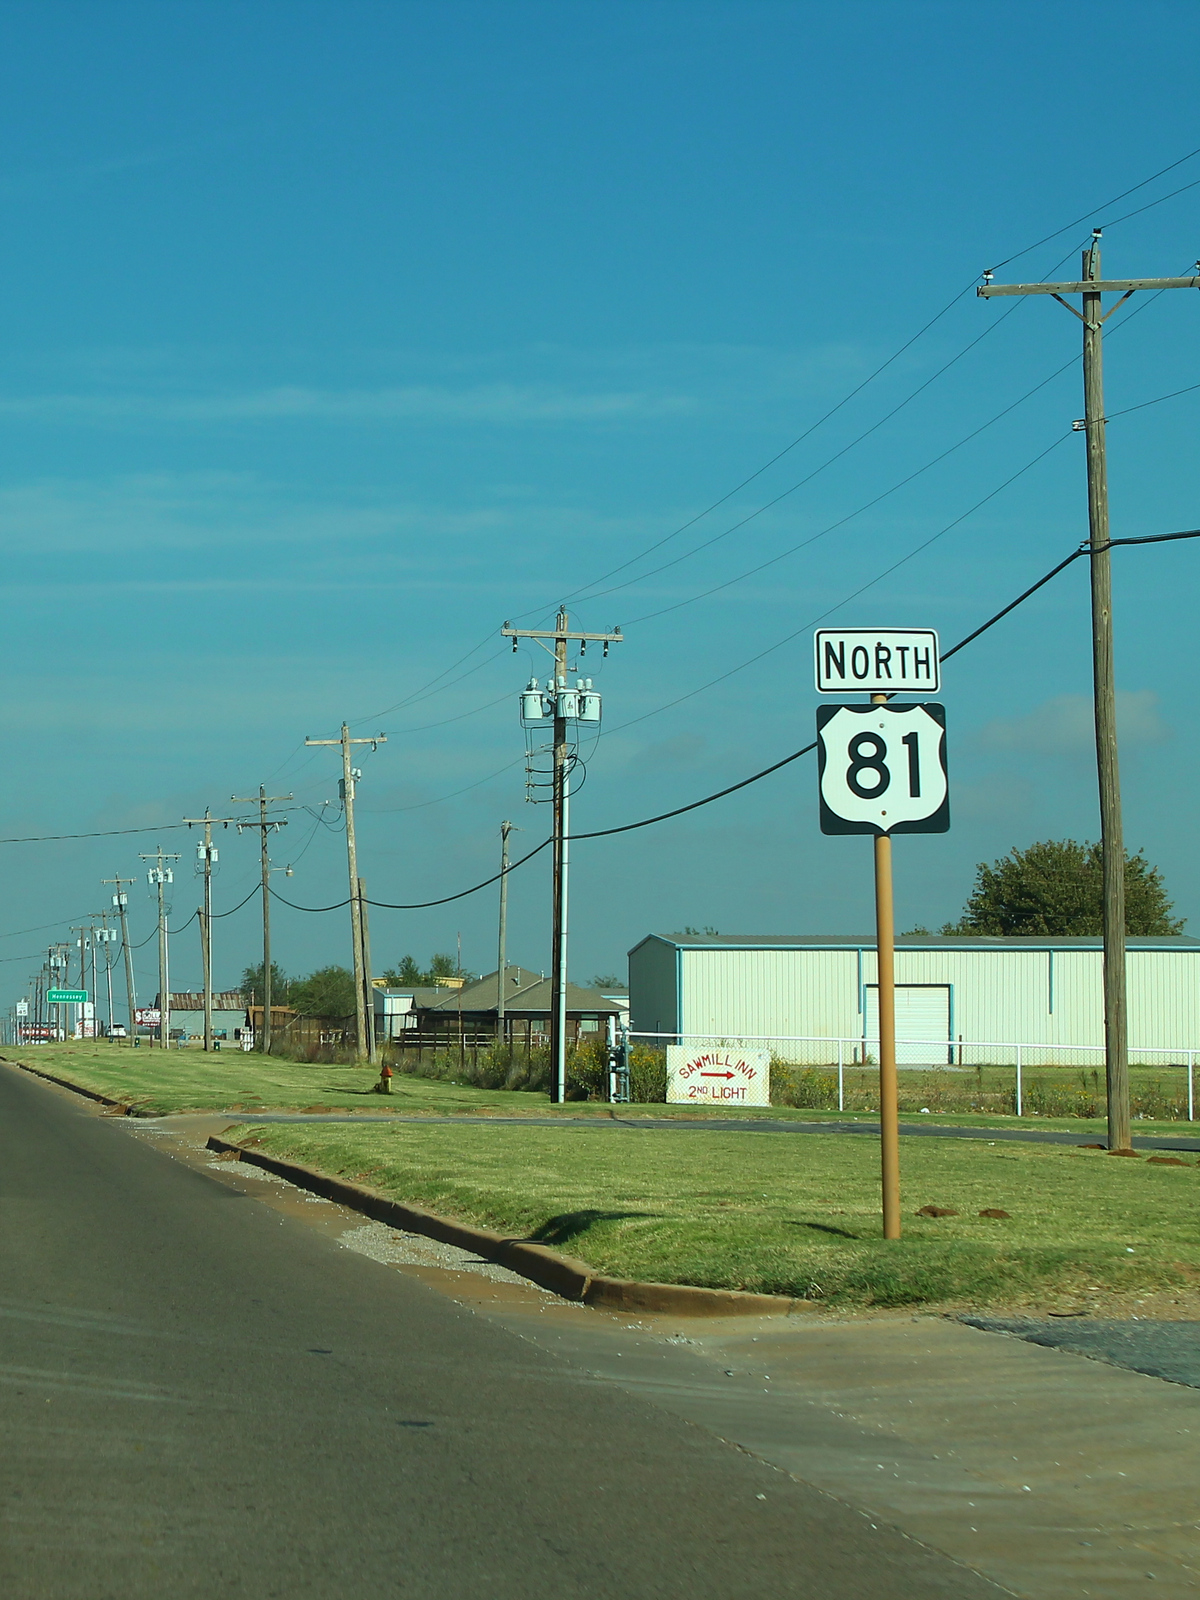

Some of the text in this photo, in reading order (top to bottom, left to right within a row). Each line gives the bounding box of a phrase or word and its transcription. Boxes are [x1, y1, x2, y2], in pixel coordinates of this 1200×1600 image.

[824, 641, 931, 680] NORTH
[846, 731, 921, 800] 81
[679, 1053, 757, 1080] SAWMILL INN
[688, 1086, 747, 1099] 2ND LIGHT
